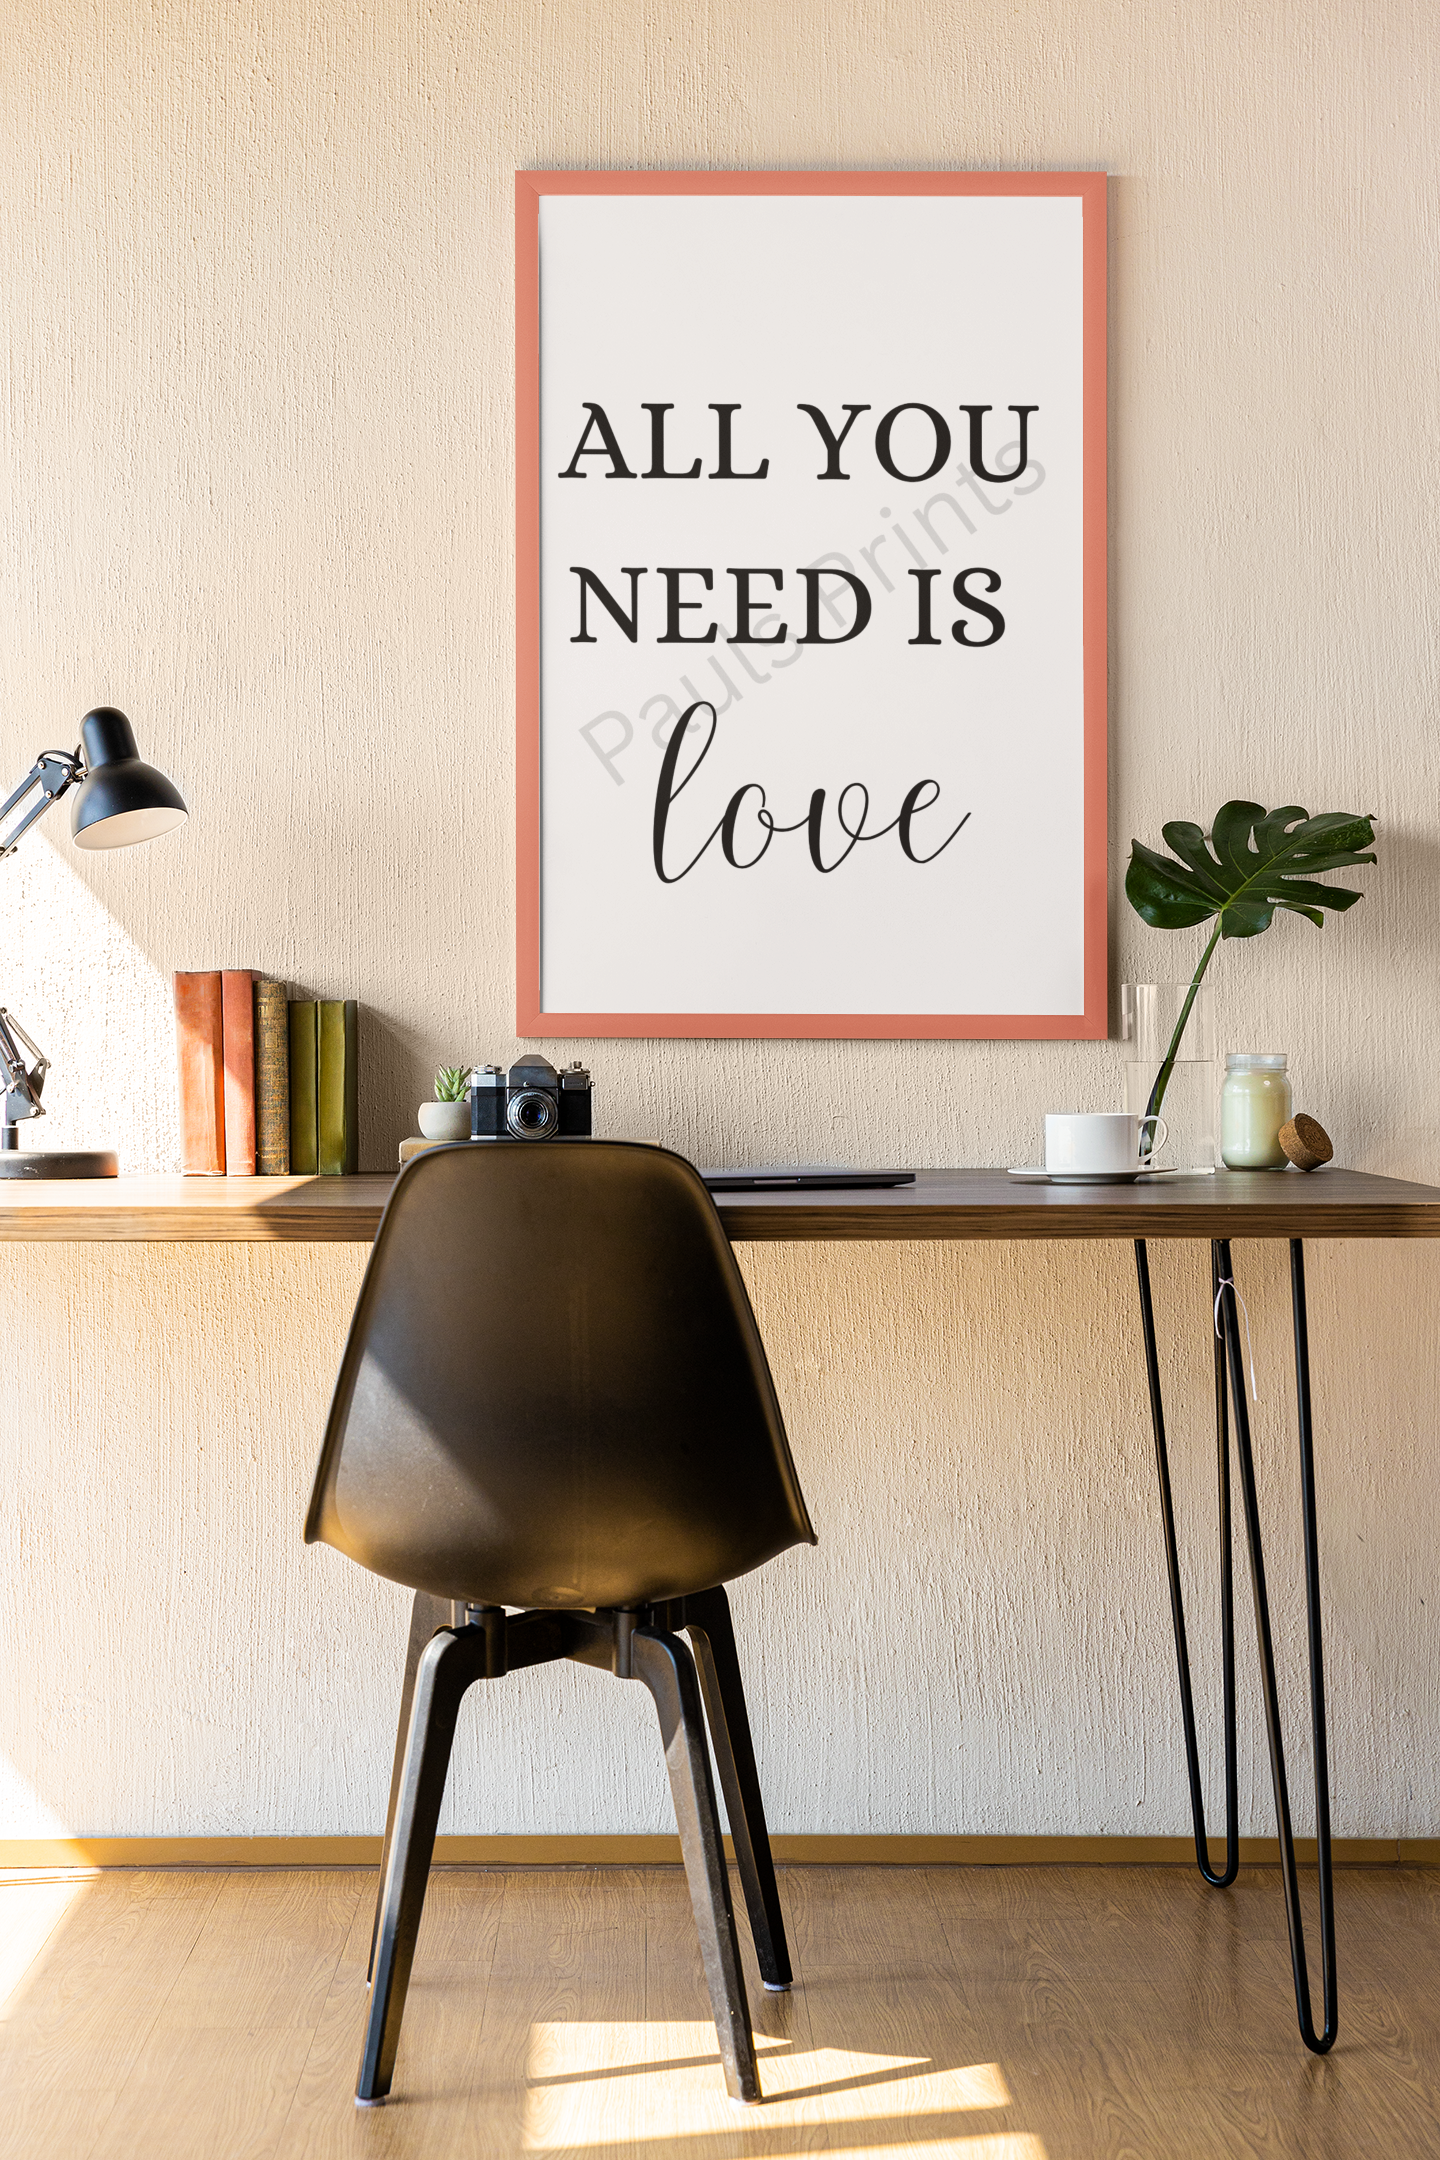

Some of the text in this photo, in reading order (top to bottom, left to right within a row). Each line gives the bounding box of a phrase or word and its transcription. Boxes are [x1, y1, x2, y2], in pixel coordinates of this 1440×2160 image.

[558, 402, 1040, 483] ALL YOU
[569, 566, 1006, 647] NEED IS
[653, 701, 972, 884] love
